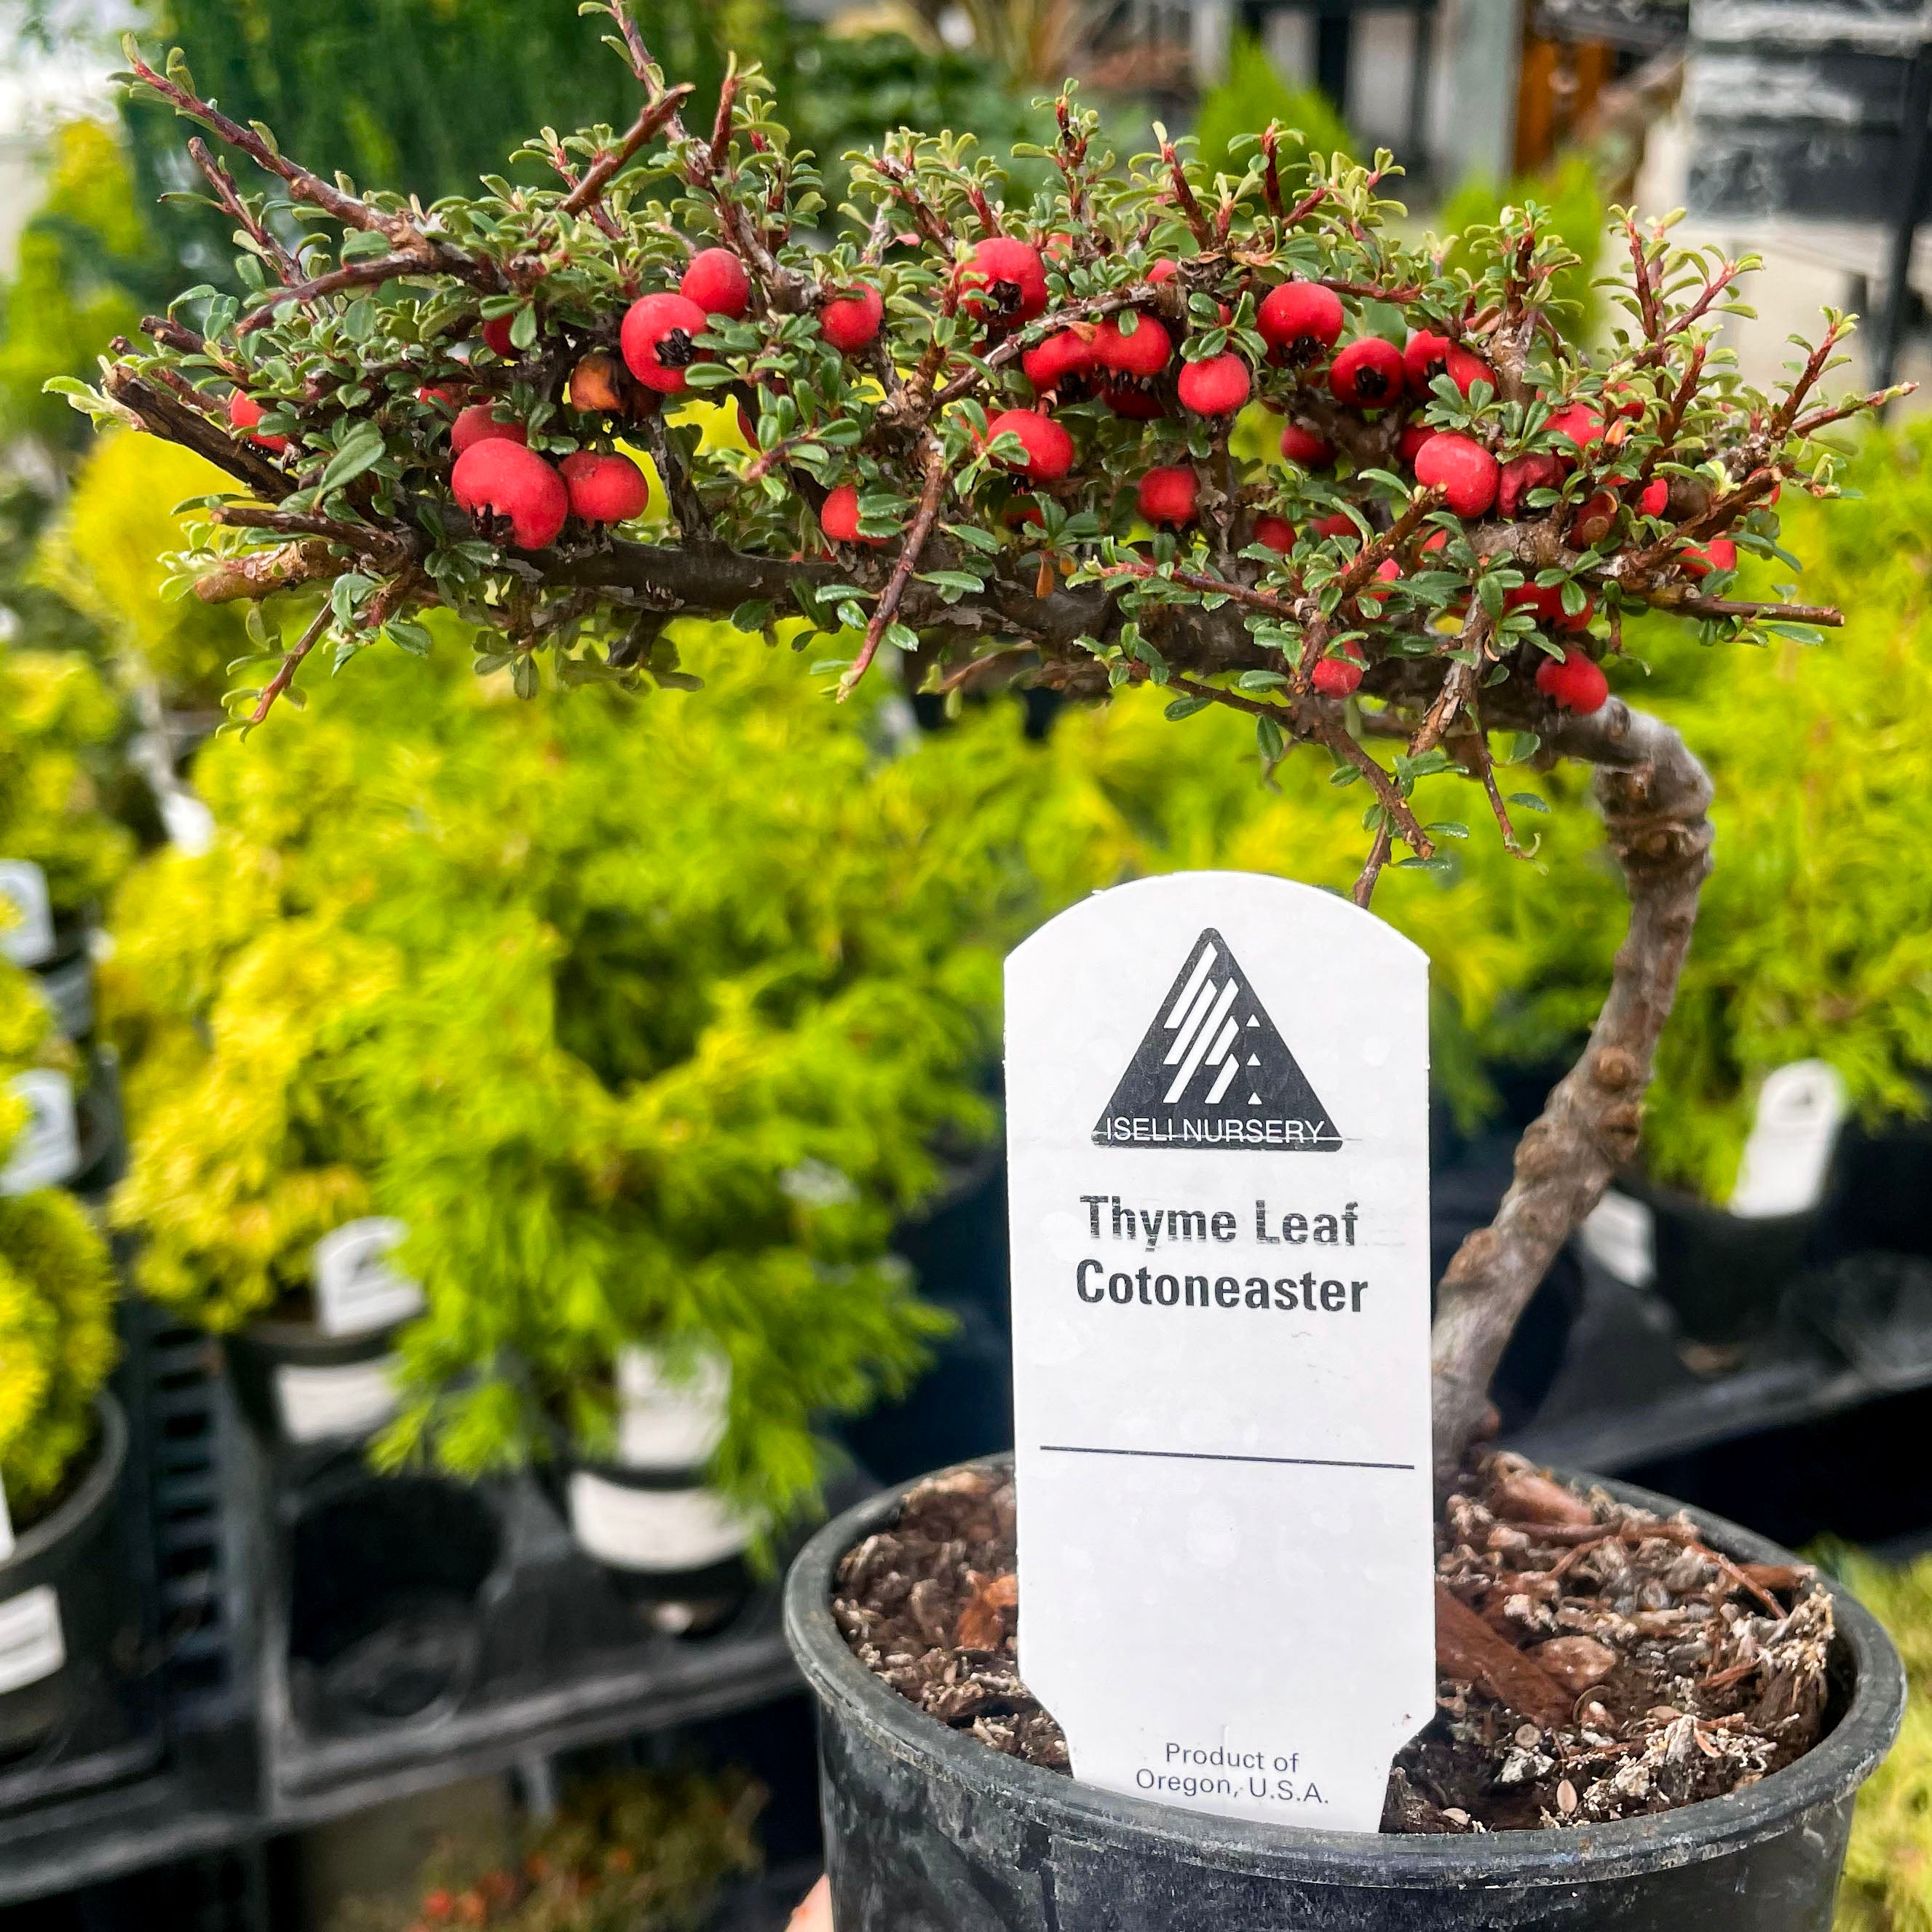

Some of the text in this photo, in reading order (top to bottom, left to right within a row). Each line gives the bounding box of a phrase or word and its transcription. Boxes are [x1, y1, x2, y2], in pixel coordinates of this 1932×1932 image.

[1106, 1116, 1325, 1144] ISELI NURSERY
[1080, 1195, 1359, 1252] Thyme Leaf
[1076, 1259, 1369, 1313] Cotoneaster
[1165, 1742, 1299, 1773] Product of
[1136, 1768, 1329, 1804] Oregon, U.S.A.
